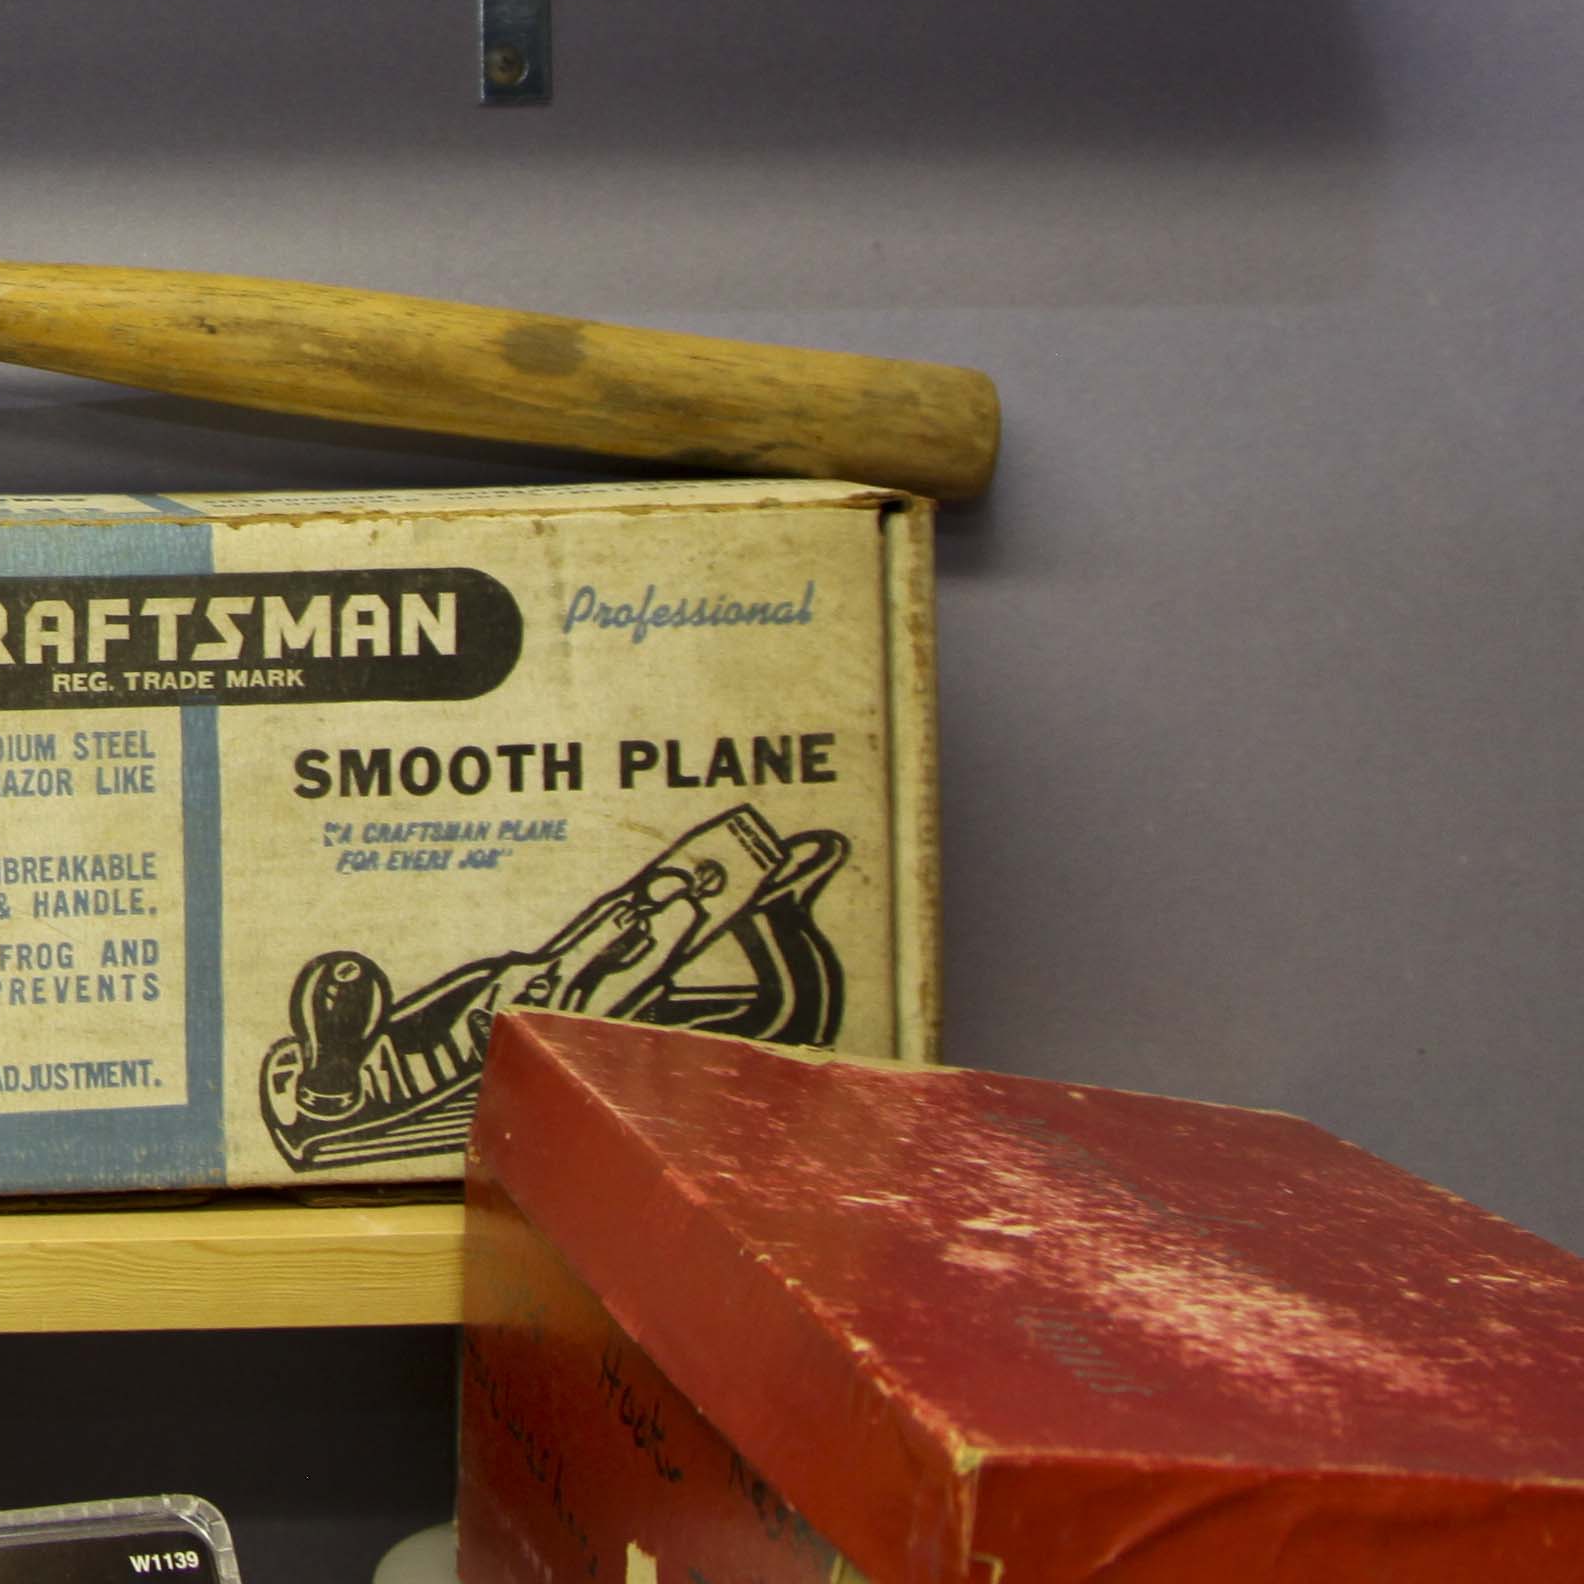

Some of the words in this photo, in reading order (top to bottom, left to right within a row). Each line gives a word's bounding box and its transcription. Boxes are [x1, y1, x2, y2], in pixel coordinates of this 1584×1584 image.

[563, 580, 817, 646] Professional
[51, 671, 113, 693] REG.
[125, 669, 213, 692] TRADE
[227, 668, 304, 689] MARK
[73, 730, 156, 761] STEEL
[95, 765, 156, 796] LIKE
[294, 743, 582, 799] SMOOTH
[619, 733, 837, 790] PLANE
[33, 888, 157, 918] HANDLE.
[100, 939, 158, 968] AND
[129, 1550, 199, 1573] W1139
